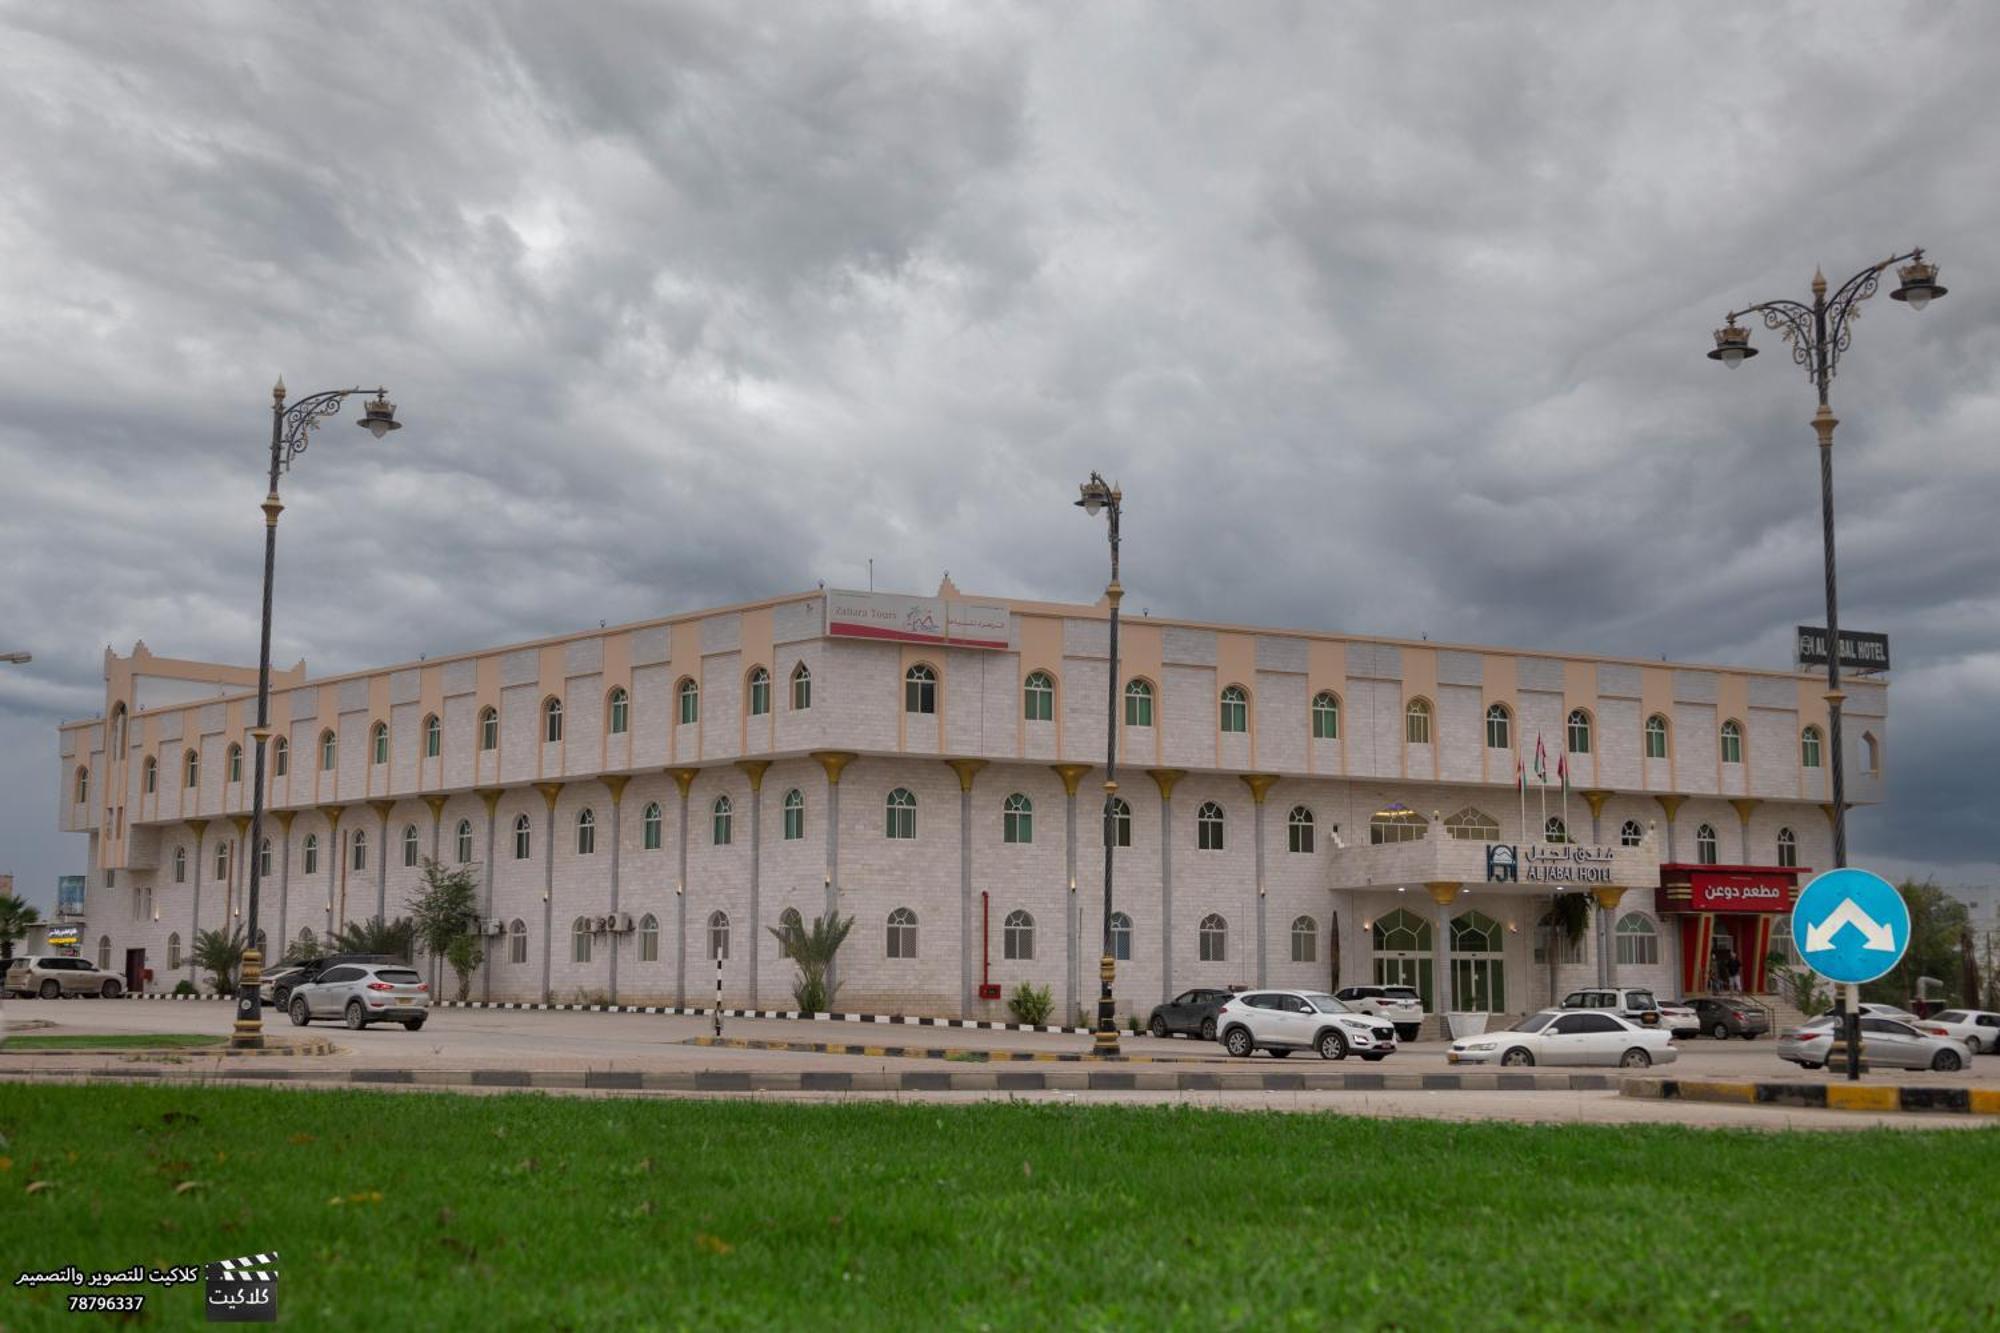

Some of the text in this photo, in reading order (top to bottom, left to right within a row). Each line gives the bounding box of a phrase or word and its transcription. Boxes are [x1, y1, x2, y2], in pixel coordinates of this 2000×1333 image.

[871, 608, 897, 620] Tours
[1839, 639, 1857, 659] BAL
[1857, 641, 1887, 661] HOTEL
[1525, 845, 1570, 865] الجبل
[1573, 847, 1615, 864] فندق
[1527, 865, 1612, 882] AL JABAL HOTEL
[1704, 884, 1780, 900] مطعم دوعن
